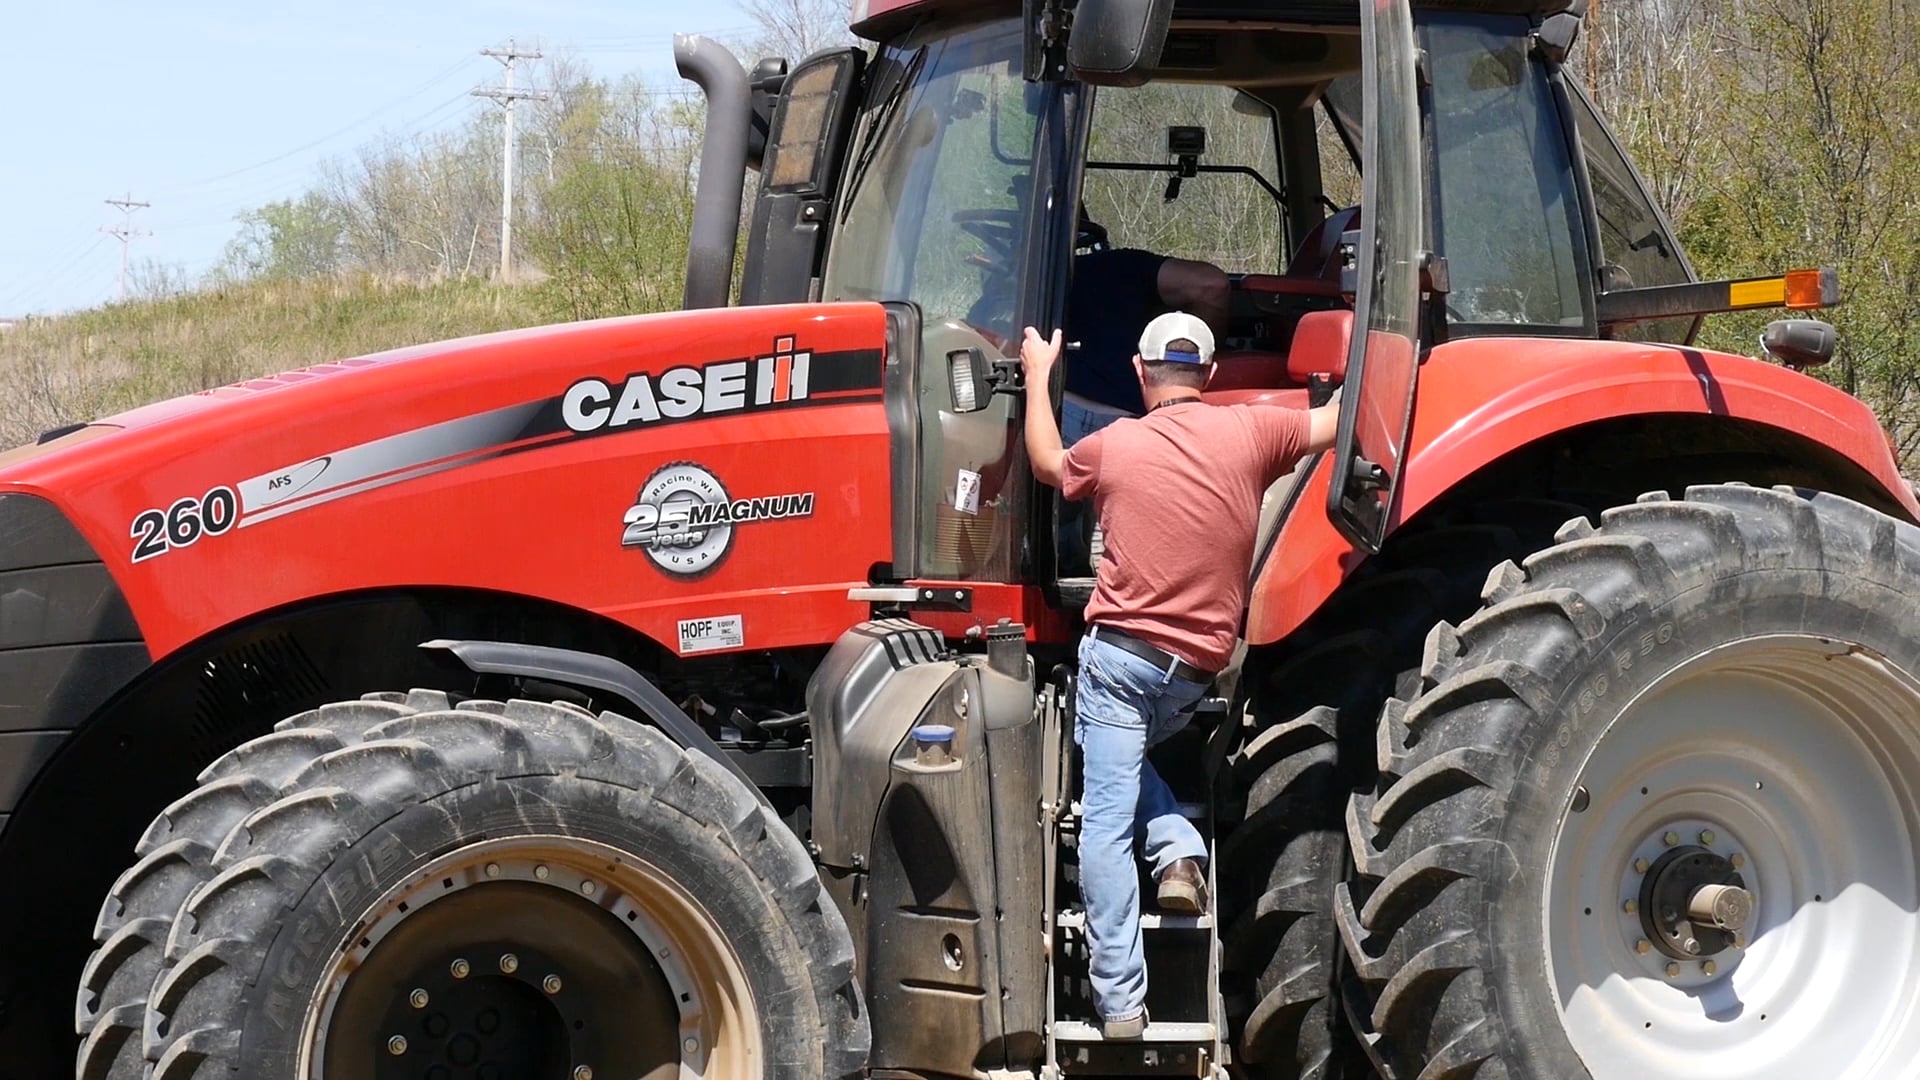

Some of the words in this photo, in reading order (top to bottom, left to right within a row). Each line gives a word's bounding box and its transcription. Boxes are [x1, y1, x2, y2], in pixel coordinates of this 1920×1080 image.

[562, 361, 747, 432] CASE
[268, 474, 292, 490] AFS
[131, 486, 237, 563] 260
[622, 499, 692, 545] 25
[688, 494, 814, 525] MAGNUM
[650, 530, 704, 549] years
[681, 620, 712, 639] HOPF
[1639, 620, 1674, 657] 50
